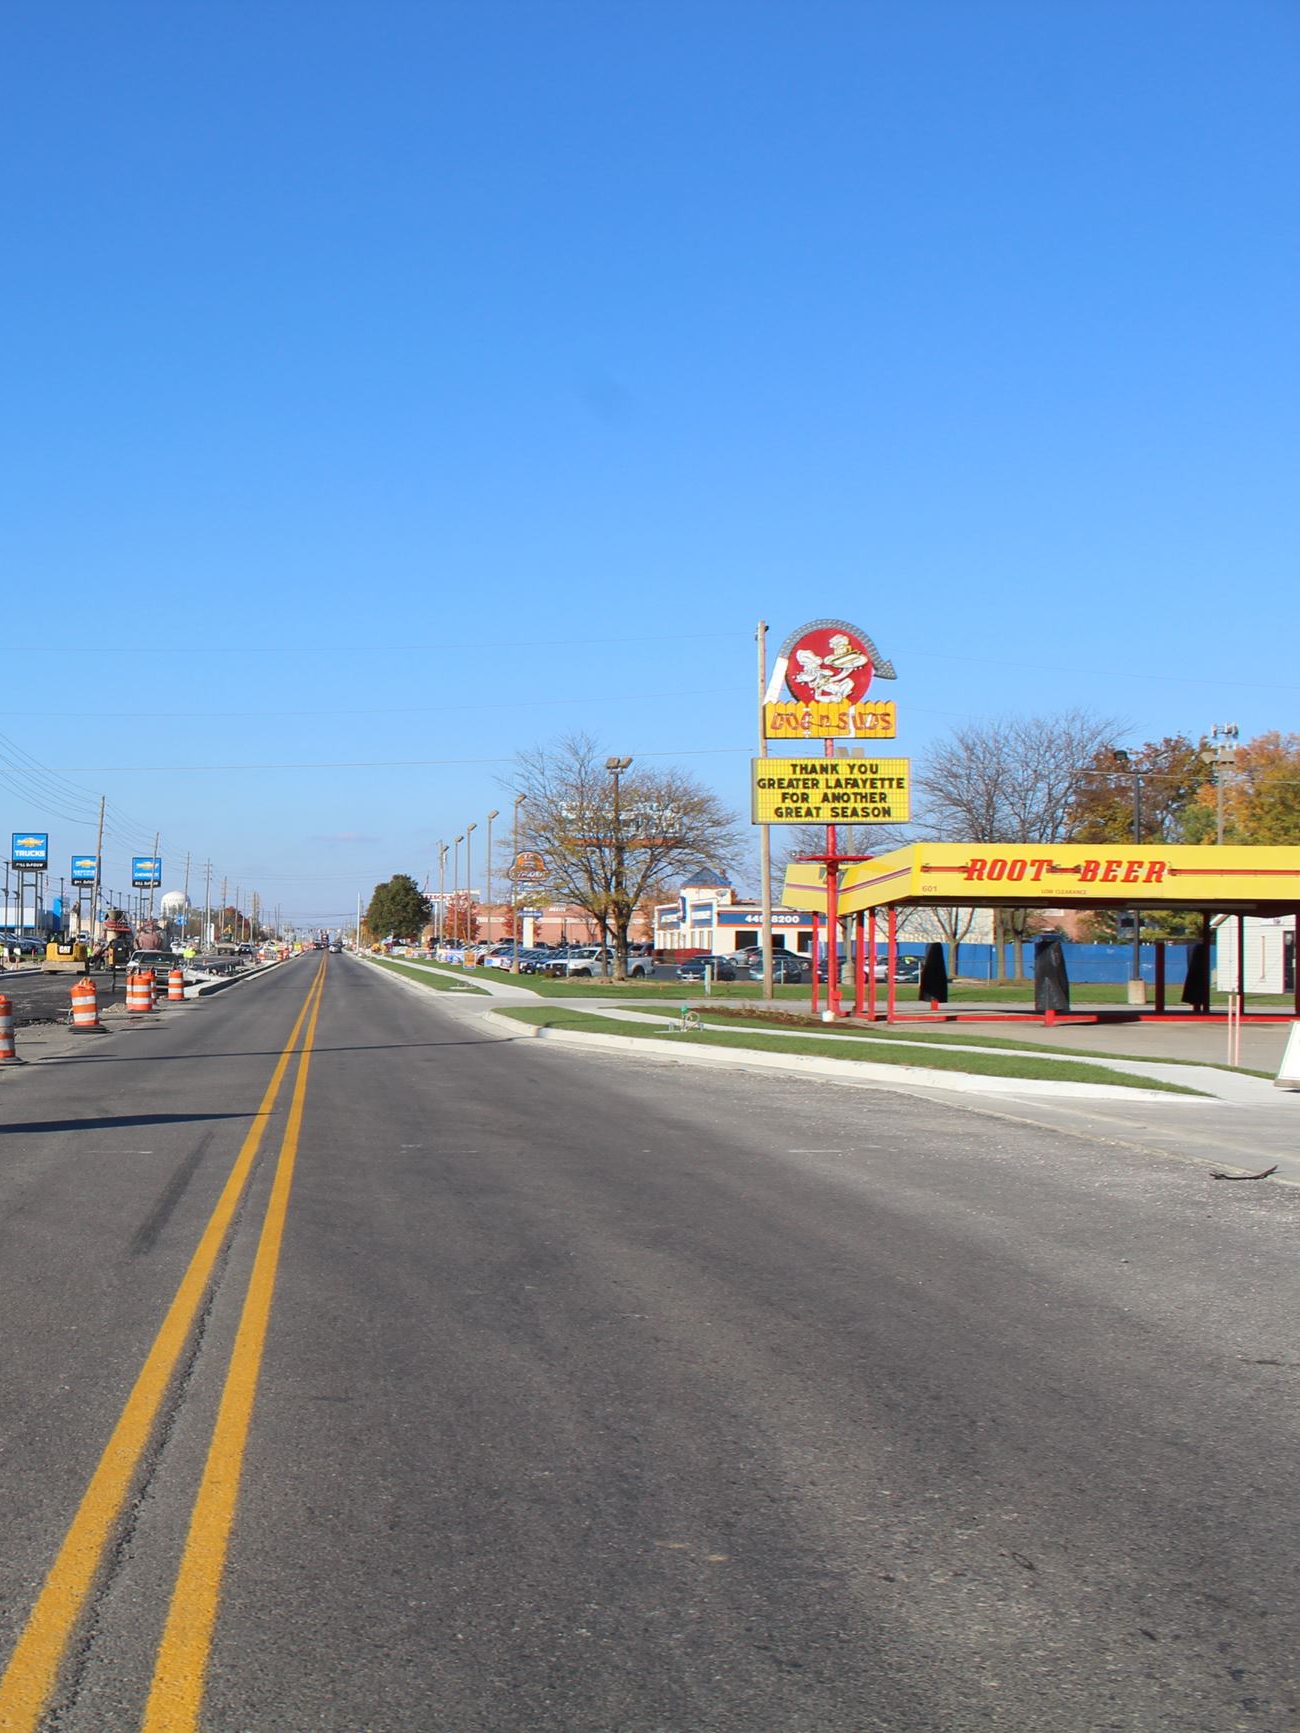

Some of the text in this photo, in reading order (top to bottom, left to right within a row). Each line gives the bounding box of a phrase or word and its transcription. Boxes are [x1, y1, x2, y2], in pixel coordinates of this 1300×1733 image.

[790, 763, 879, 775] THANK YOU
[757, 778, 905, 789] GREATER LAFAYETTE
[781, 792, 888, 803] FOR ANOTHER
[774, 806, 892, 817] GREAT SEASON
[964, 859, 1166, 883] ROOT BEER
